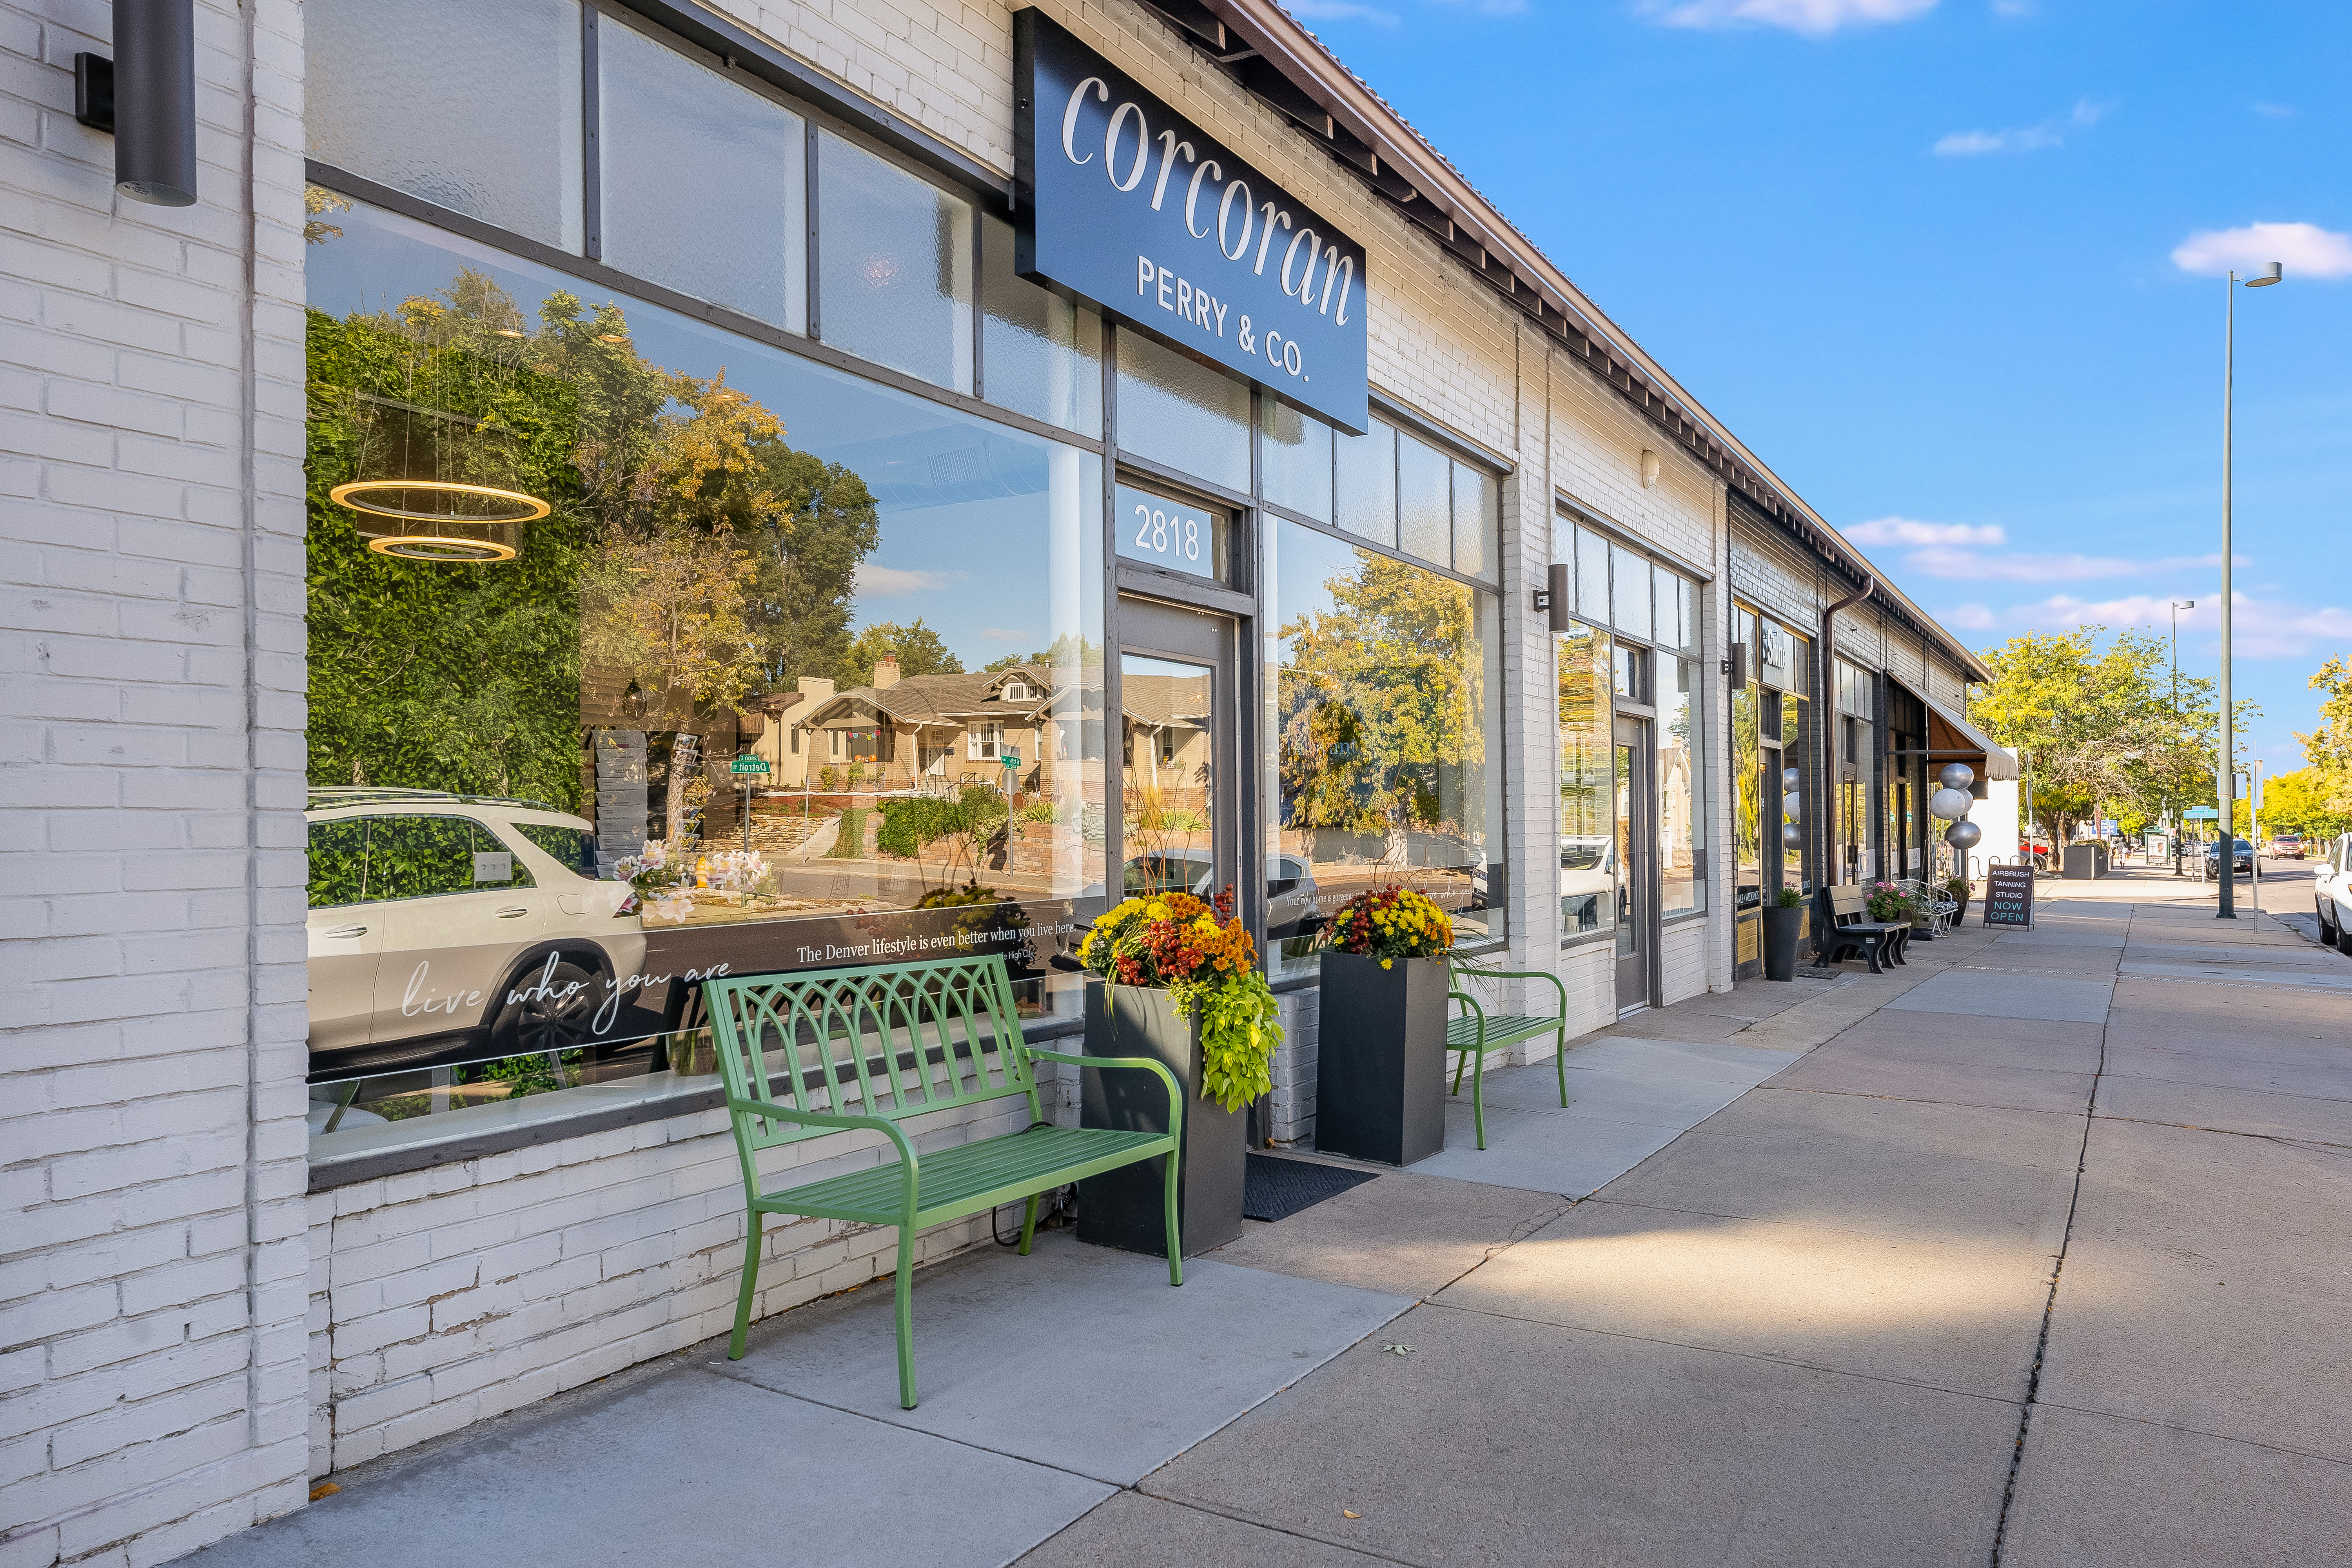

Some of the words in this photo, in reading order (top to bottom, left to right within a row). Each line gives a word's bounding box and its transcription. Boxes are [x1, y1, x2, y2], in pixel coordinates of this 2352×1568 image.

[1062, 77, 1353, 326] corcoran
[1137, 255, 1228, 337] PERRY
[1238, 314, 1256, 355] &
[1265, 330, 1309, 382] CO.
[1134, 504, 1200, 561] 2818
[1286, 896, 1299, 906] Your
[1312, 893, 1326, 904] home
[1327, 893, 1331, 902] is
[1991, 912, 2023, 921] OPEN
[1994, 902, 2022, 911] NOW
[797, 946, 822, 963] The
[825, 941, 868, 960] Denver
[872, 935, 916, 957] lifestyle
[919, 935, 928, 949] is
[931, 935, 955, 949] even
[958, 930, 988, 946] better
[990, 926, 1017, 941] when
[1018, 927, 1035, 942] you
[1037, 923, 1053, 936] live
[1055, 921, 1076, 935] here.
[1009, 951, 1022, 960] High
[402, 960, 485, 1017] live
[506, 951, 589, 1005] who
[592, 972, 671, 1034] you
[684, 962, 732, 982] are
